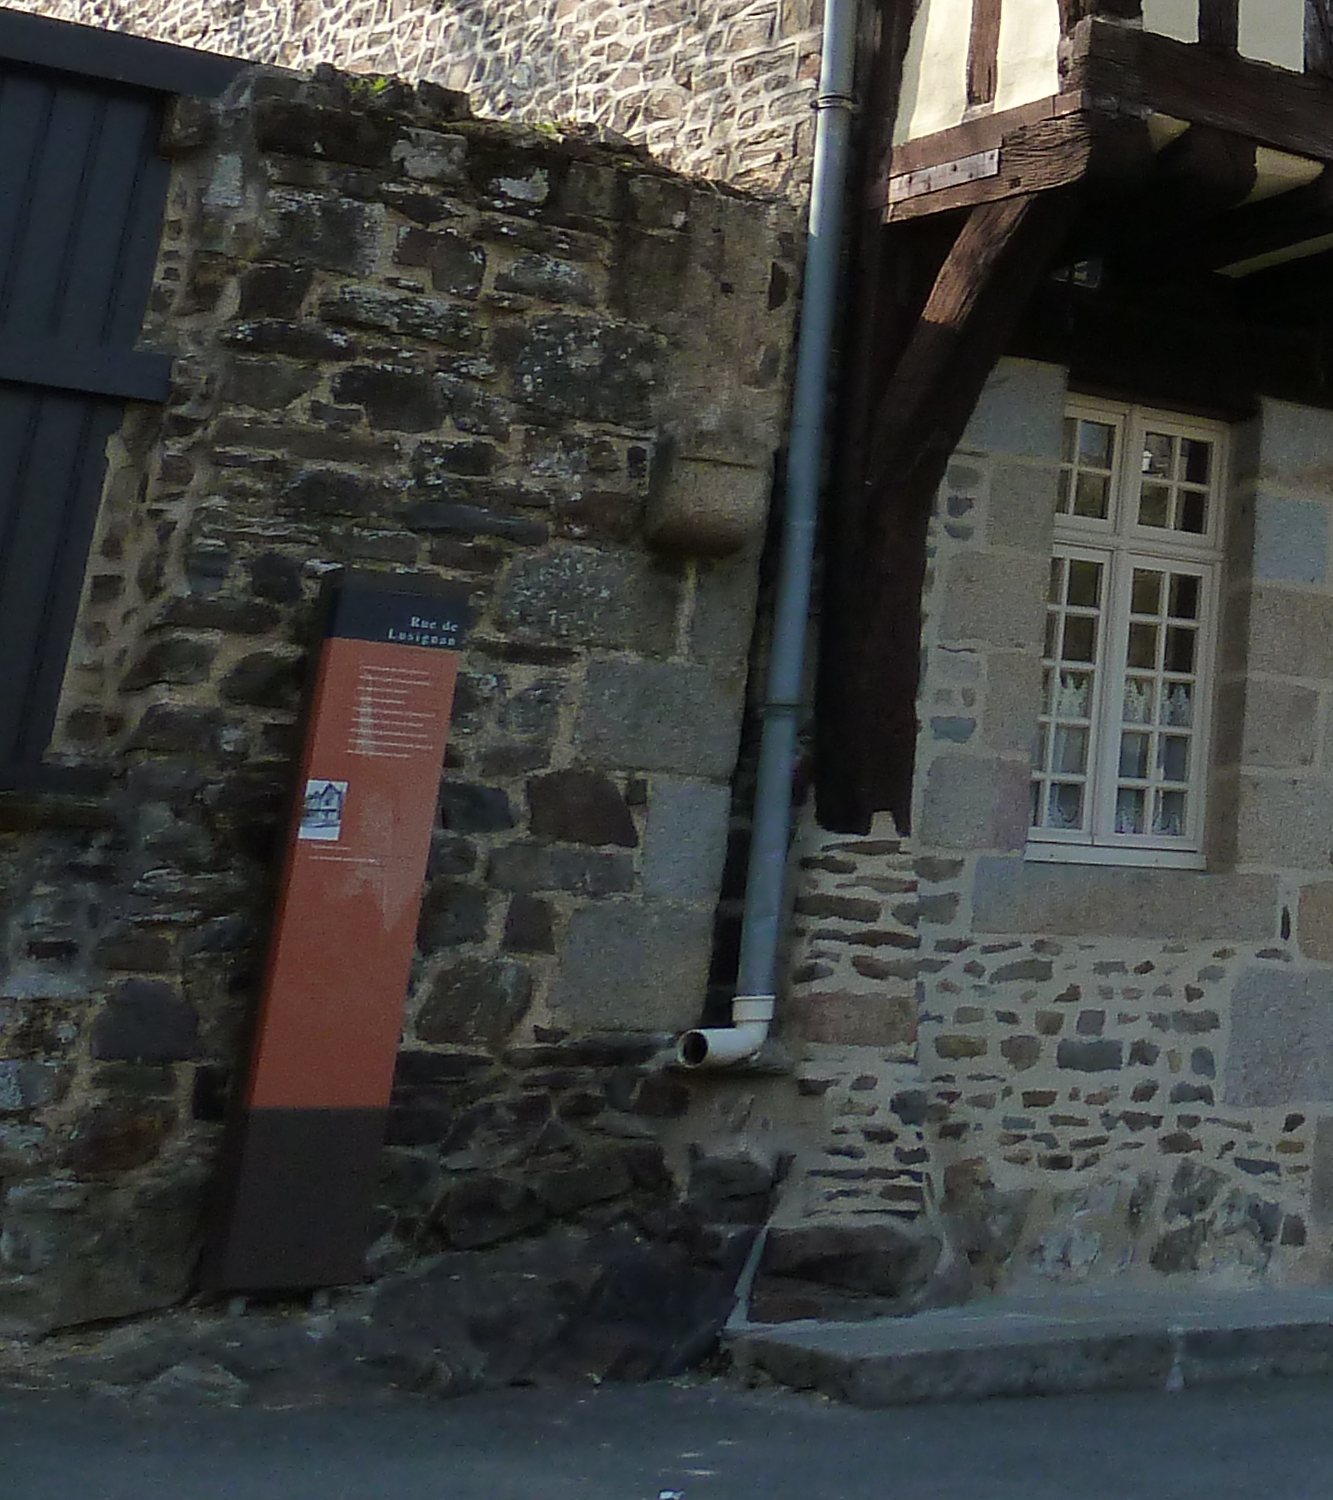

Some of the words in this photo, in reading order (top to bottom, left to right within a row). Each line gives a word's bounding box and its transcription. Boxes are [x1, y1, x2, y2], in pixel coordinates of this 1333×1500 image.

[411, 616, 437, 629] Rue
[442, 620, 458, 632] de
[388, 628, 456, 645] Lusignan
